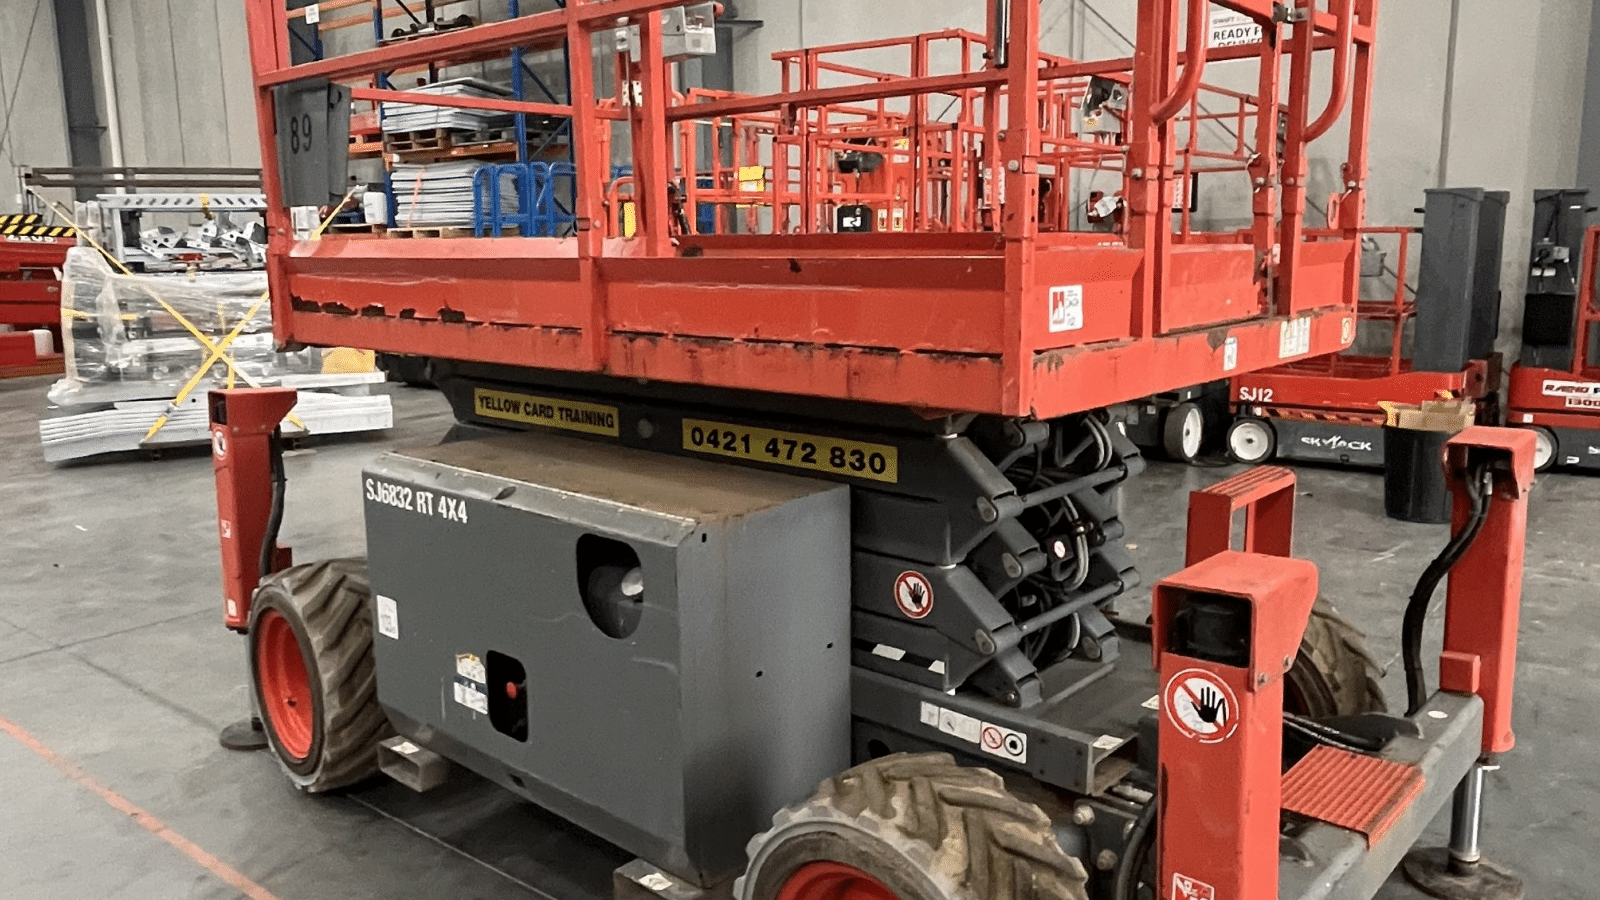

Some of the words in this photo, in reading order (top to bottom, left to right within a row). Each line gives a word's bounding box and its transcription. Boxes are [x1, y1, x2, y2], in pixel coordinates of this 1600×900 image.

[1213, 27, 1251, 40] READY
[290, 114, 312, 154] 89
[1239, 387, 1274, 402] SJ12
[479, 395, 521, 414] YELLOW
[523, 401, 554, 419] CARD
[557, 406, 615, 429] TRAINING
[691, 426, 751, 454] 0421
[764, 437, 817, 465] 472
[829, 446, 886, 475] 830
[1300, 435, 1372, 451] SKYJACK
[365, 478, 414, 511] SJ6832
[416, 491, 434, 516] RT
[437, 495, 468, 524] 4X4
